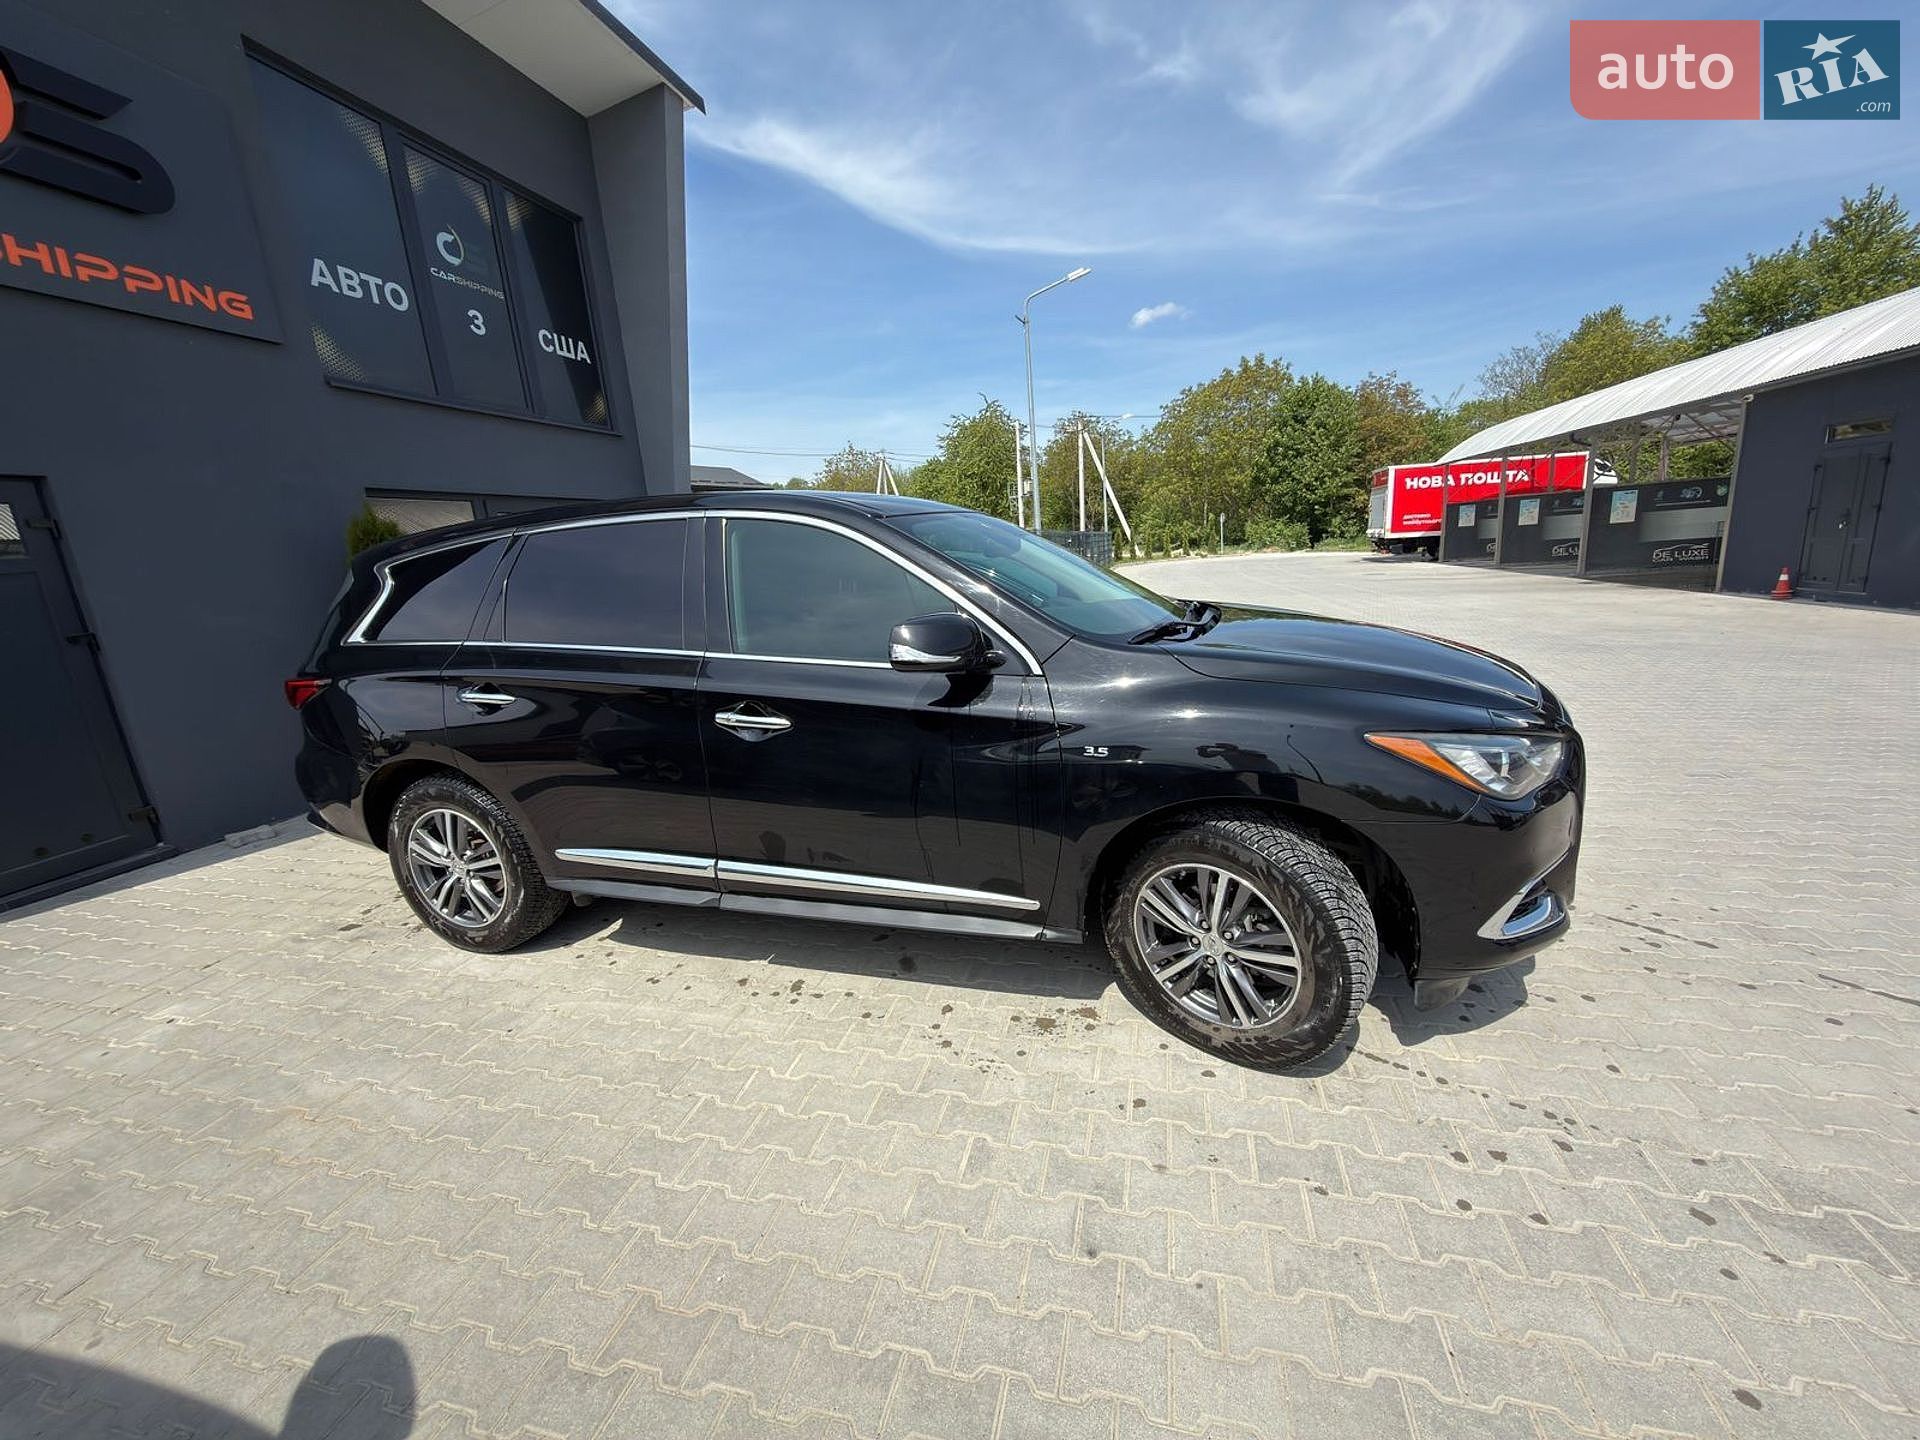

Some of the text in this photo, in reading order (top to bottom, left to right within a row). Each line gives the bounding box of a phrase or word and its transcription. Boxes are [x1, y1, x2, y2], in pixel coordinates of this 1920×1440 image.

[0, 233, 254, 320] HIPPING
[311, 258, 409, 312] АВТО
[538, 329, 592, 365] США
[1405, 469, 1530, 490] НОВА ПОШТА
